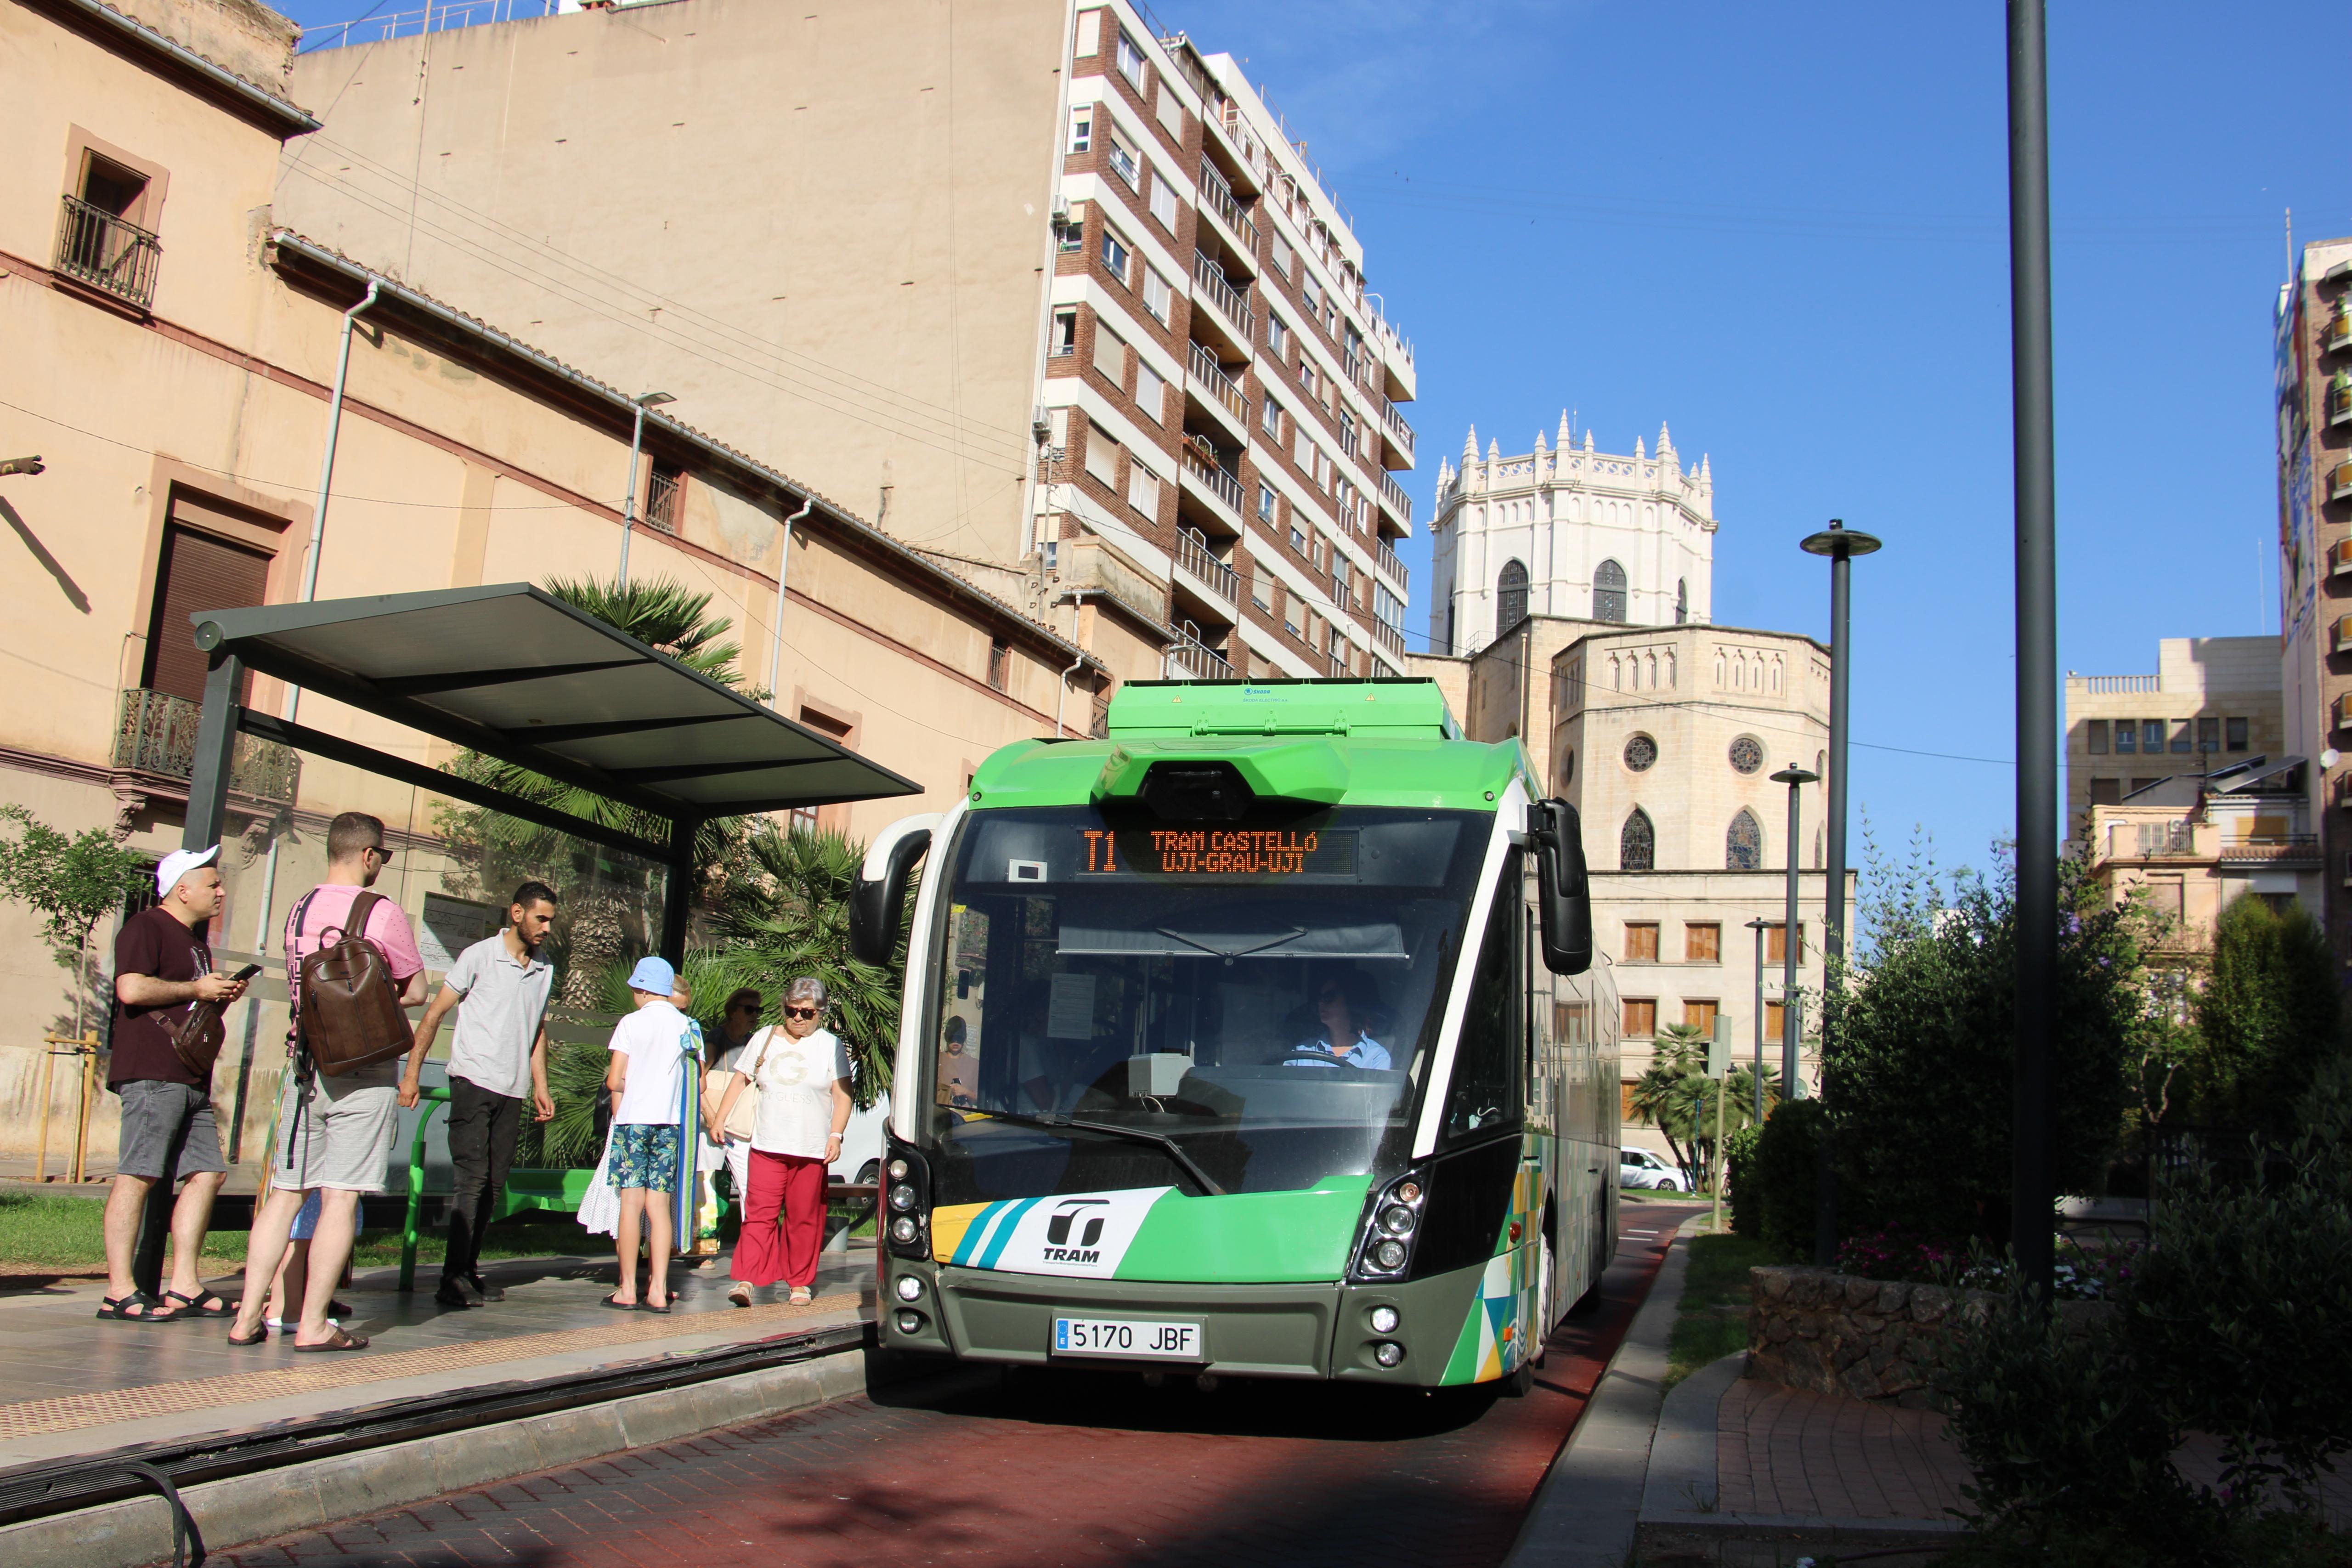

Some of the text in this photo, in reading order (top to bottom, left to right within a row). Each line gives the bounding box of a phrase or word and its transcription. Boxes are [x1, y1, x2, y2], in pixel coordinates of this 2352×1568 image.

[1084, 831, 1116, 871] T1
[1151, 831, 1317, 851] TRAM CASTELLÓ
[1163, 853, 1303, 872] UJI-GRAU-UJI
[769, 1051, 808, 1086] G
[776, 1092, 812, 1105] GUESS
[1043, 1248, 1100, 1263] TRAM
[1074, 1324, 1193, 1351] 5170 JBF
